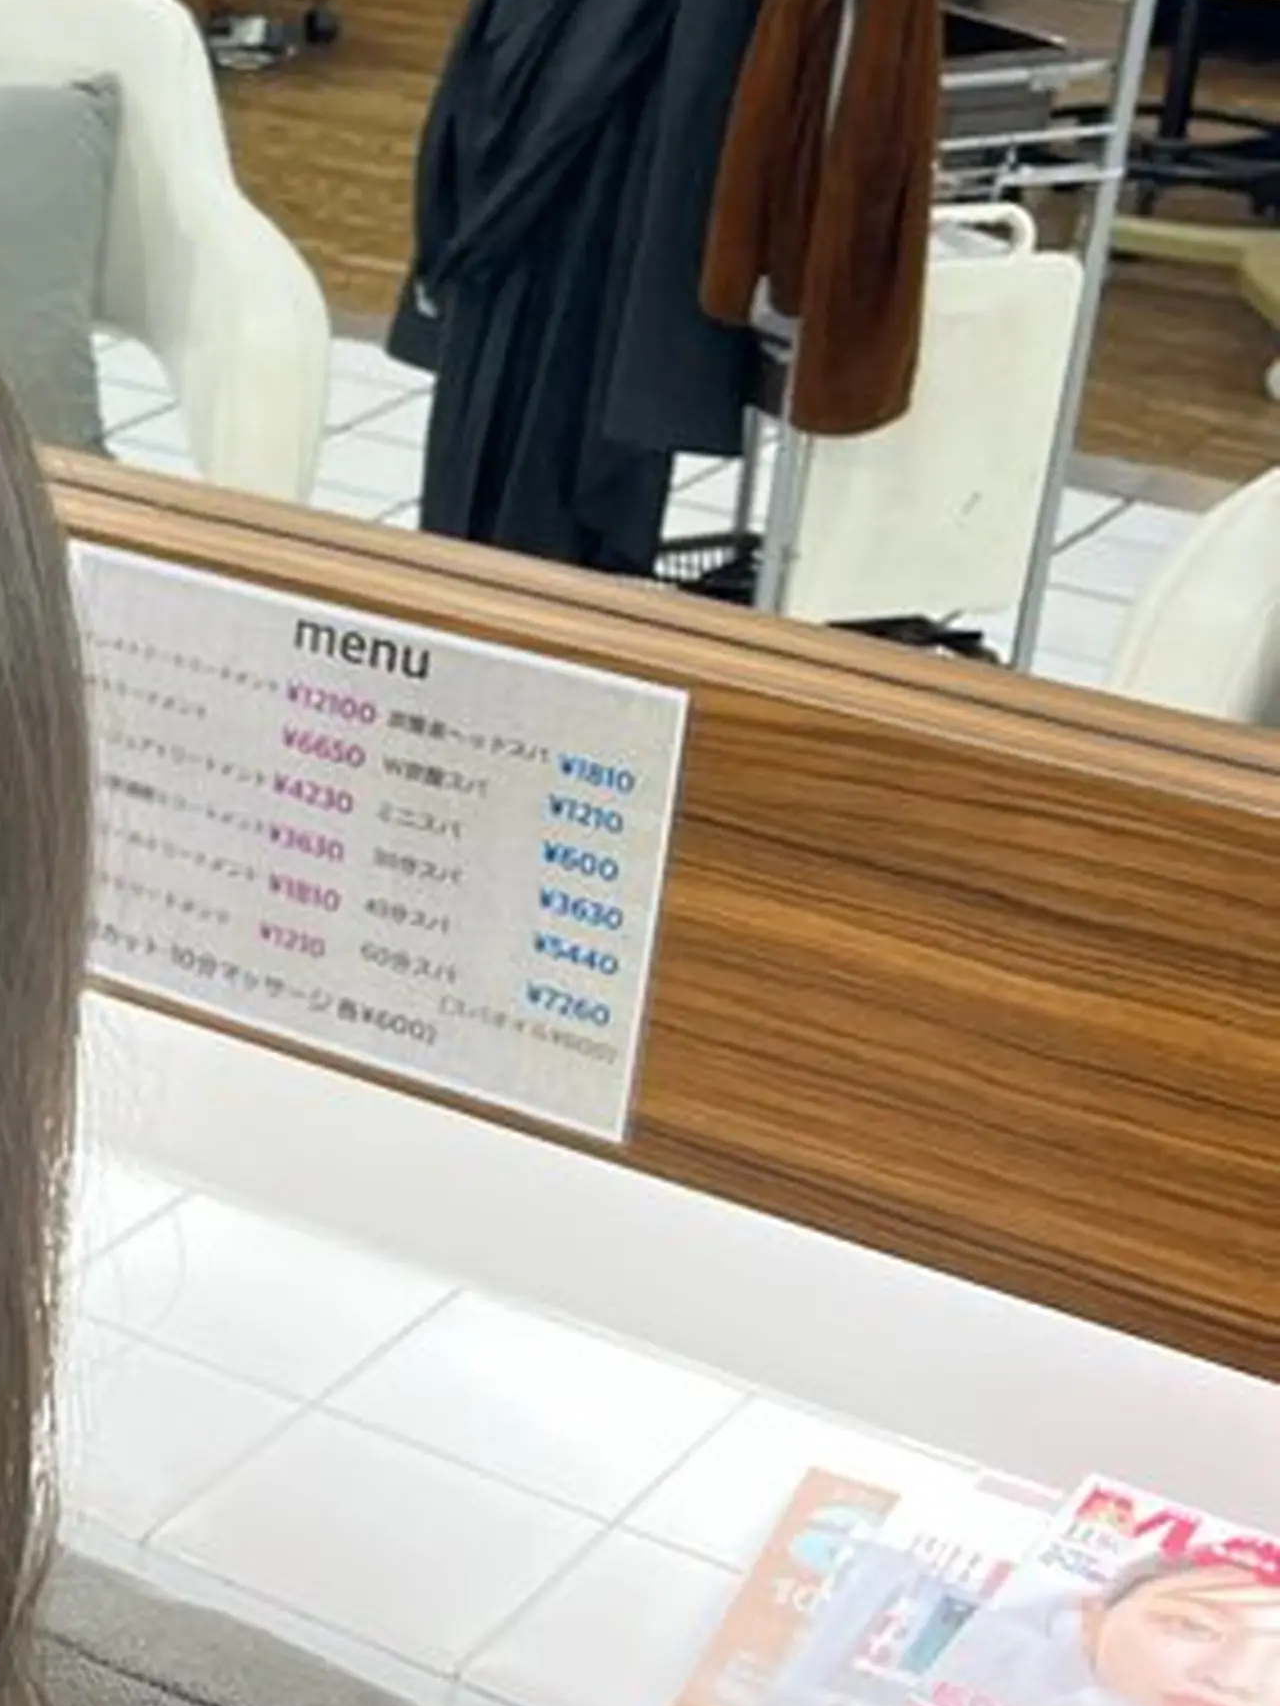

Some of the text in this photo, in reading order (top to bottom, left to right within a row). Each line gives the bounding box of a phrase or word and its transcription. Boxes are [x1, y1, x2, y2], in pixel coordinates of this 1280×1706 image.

[294, 617, 431, 680] menu
[286, 677, 377, 725] ¥12100
[282, 724, 367, 769] ¥6650
[272, 770, 355, 816] ¥4230
[557, 752, 636, 795] ¥1810
[548, 793, 625, 835] ¥1210
[269, 821, 346, 863] ¥3630
[542, 839, 620, 882] ¥600
[268, 872, 342, 913] ¥1810
[539, 886, 625, 931] ¥3630
[259, 920, 327, 959] ¥1210
[532, 930, 620, 976] ¥5440
[526, 979, 612, 1027] ¥7260
